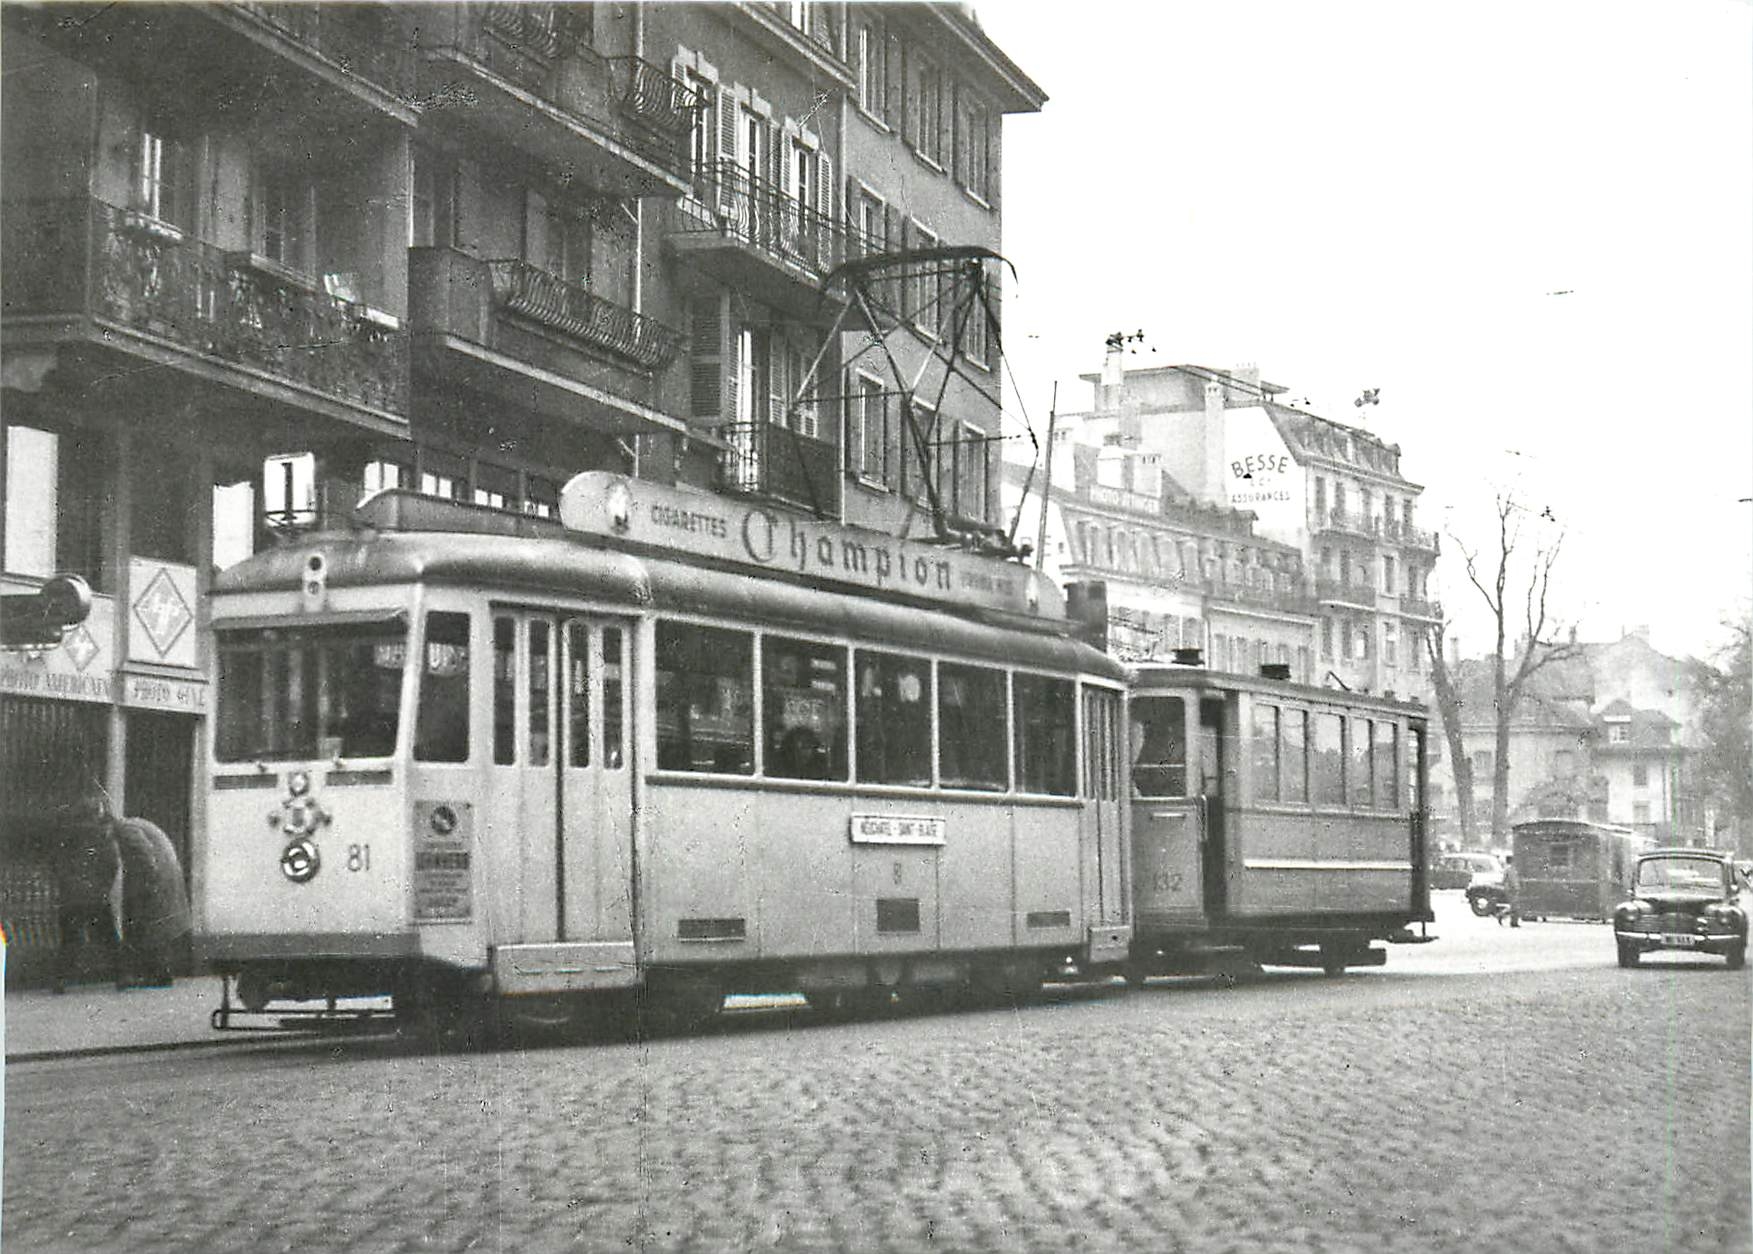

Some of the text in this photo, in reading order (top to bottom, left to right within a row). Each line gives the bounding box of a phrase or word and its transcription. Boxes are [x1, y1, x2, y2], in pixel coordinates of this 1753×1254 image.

[1231, 454, 1288, 478] BESSE
[1231, 490, 1290, 503] ASSURANCES
[651, 504, 727, 539] CIGARETTES
[742, 509, 951, 591] Champion
[347, 843, 371, 872] 81
